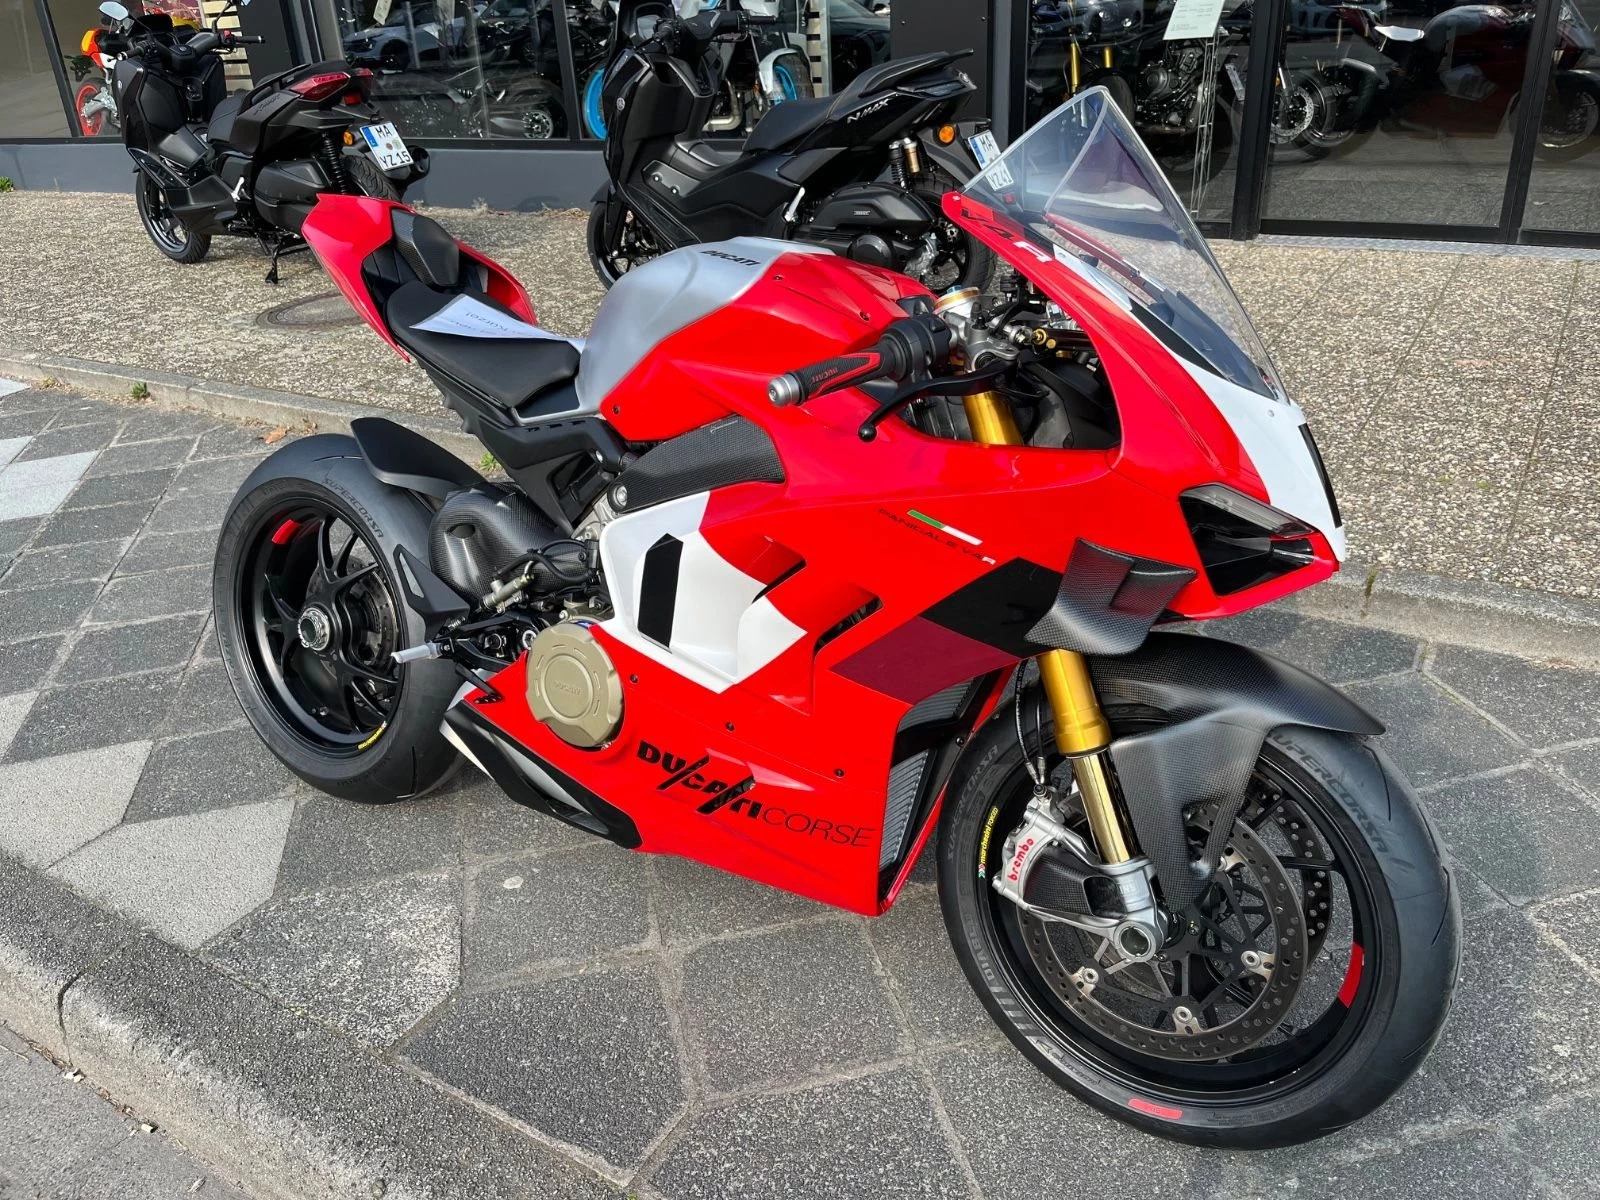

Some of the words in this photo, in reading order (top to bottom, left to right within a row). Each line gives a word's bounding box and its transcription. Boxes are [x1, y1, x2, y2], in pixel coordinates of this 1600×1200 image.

[375, 124, 393, 138] MA
[699, 249, 762, 266] DUCATI
[322, 477, 384, 538] SUPERCORSA
[636, 739, 764, 819] DUCATI
[762, 806, 877, 847] CORSE
[947, 743, 999, 861] SUPERCORSA
[1266, 733, 1389, 853] UPERCORSA
[1007, 837, 1035, 882] brembo
